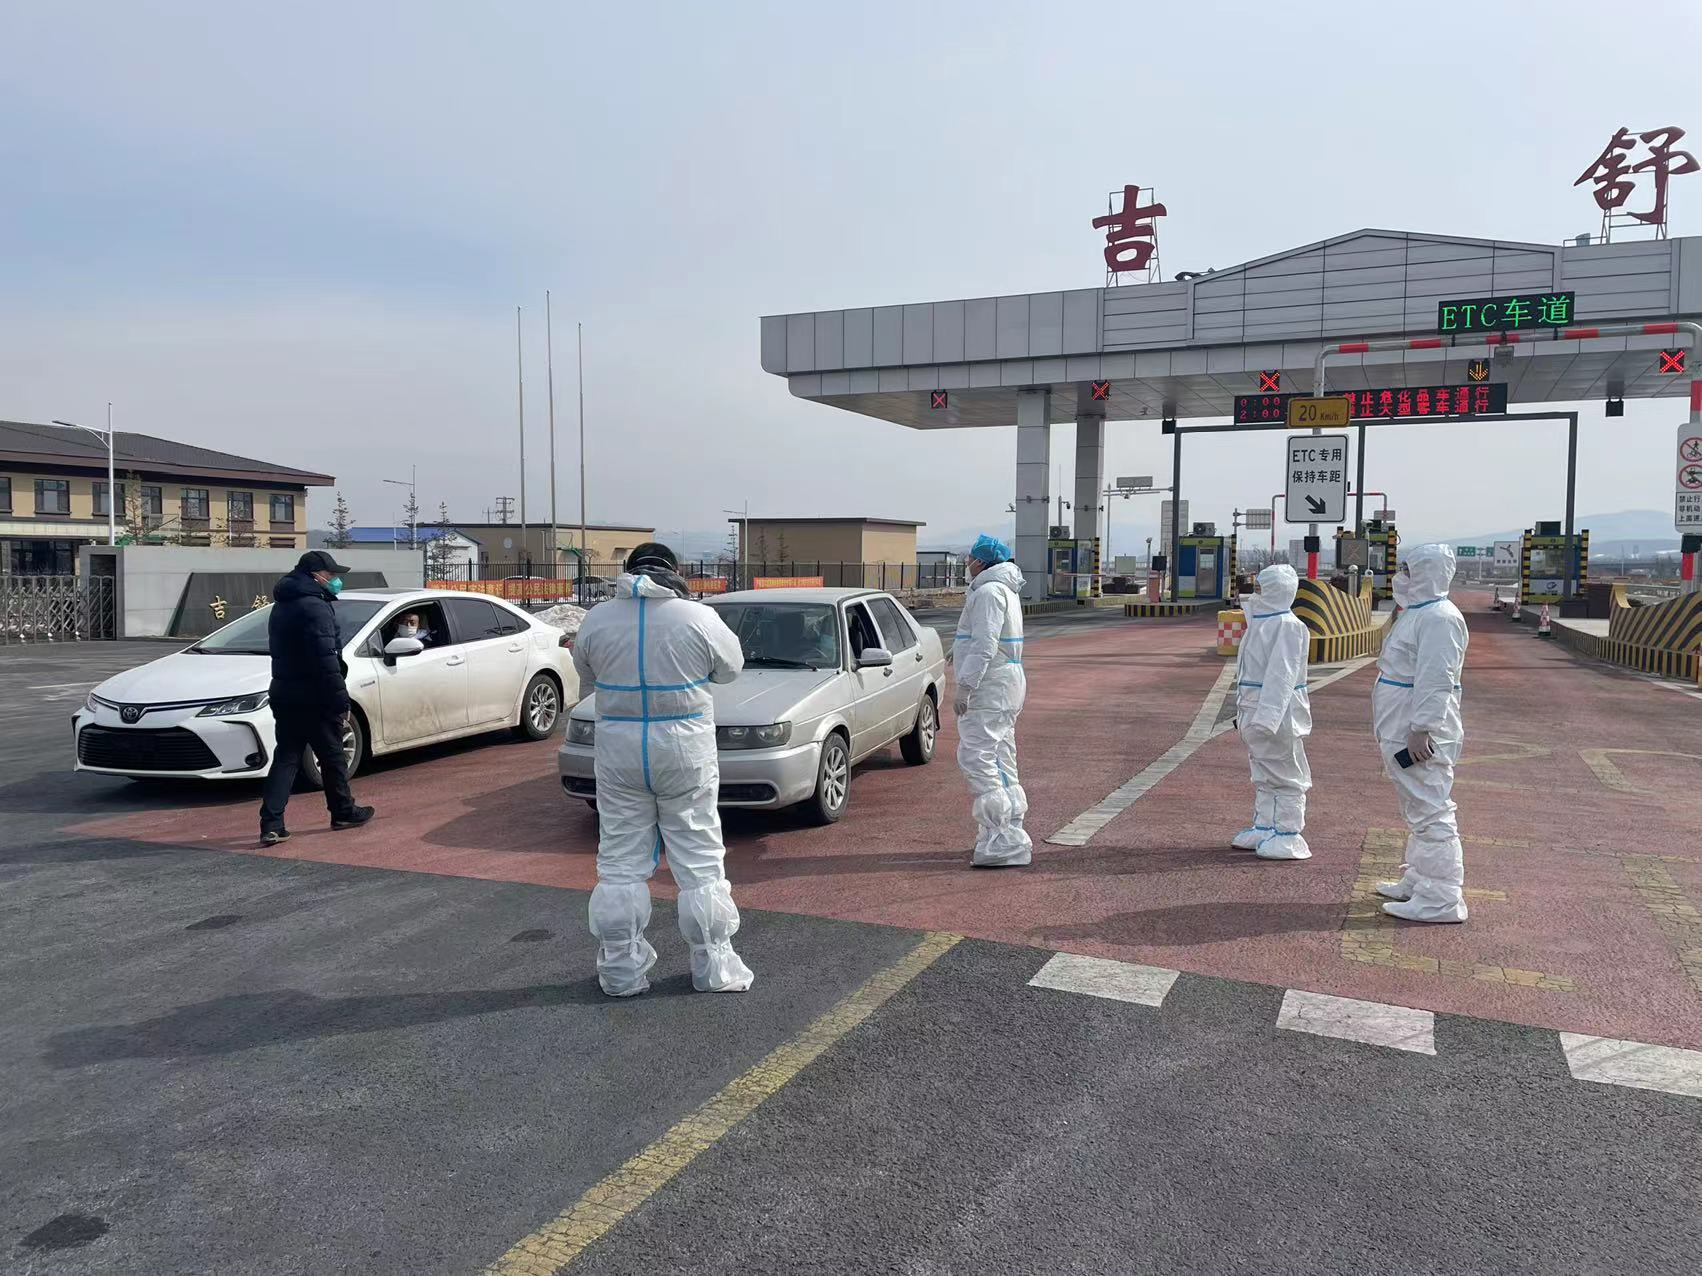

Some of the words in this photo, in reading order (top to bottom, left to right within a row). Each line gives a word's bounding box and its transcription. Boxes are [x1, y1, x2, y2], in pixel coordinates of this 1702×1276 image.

[1092, 185, 1167, 272] 吉
[1574, 126, 1701, 225] 舒
[1441, 295, 1571, 330] ETC车道
[1299, 405, 1317, 422] 20
[1292, 448, 1342, 462] ETC专用
[1292, 470, 1341, 484] 保持车距
[1679, 495, 1702, 503] 禁止行
[1679, 504, 1702, 513] 非机动
[1679, 514, 1702, 522] 上高速
